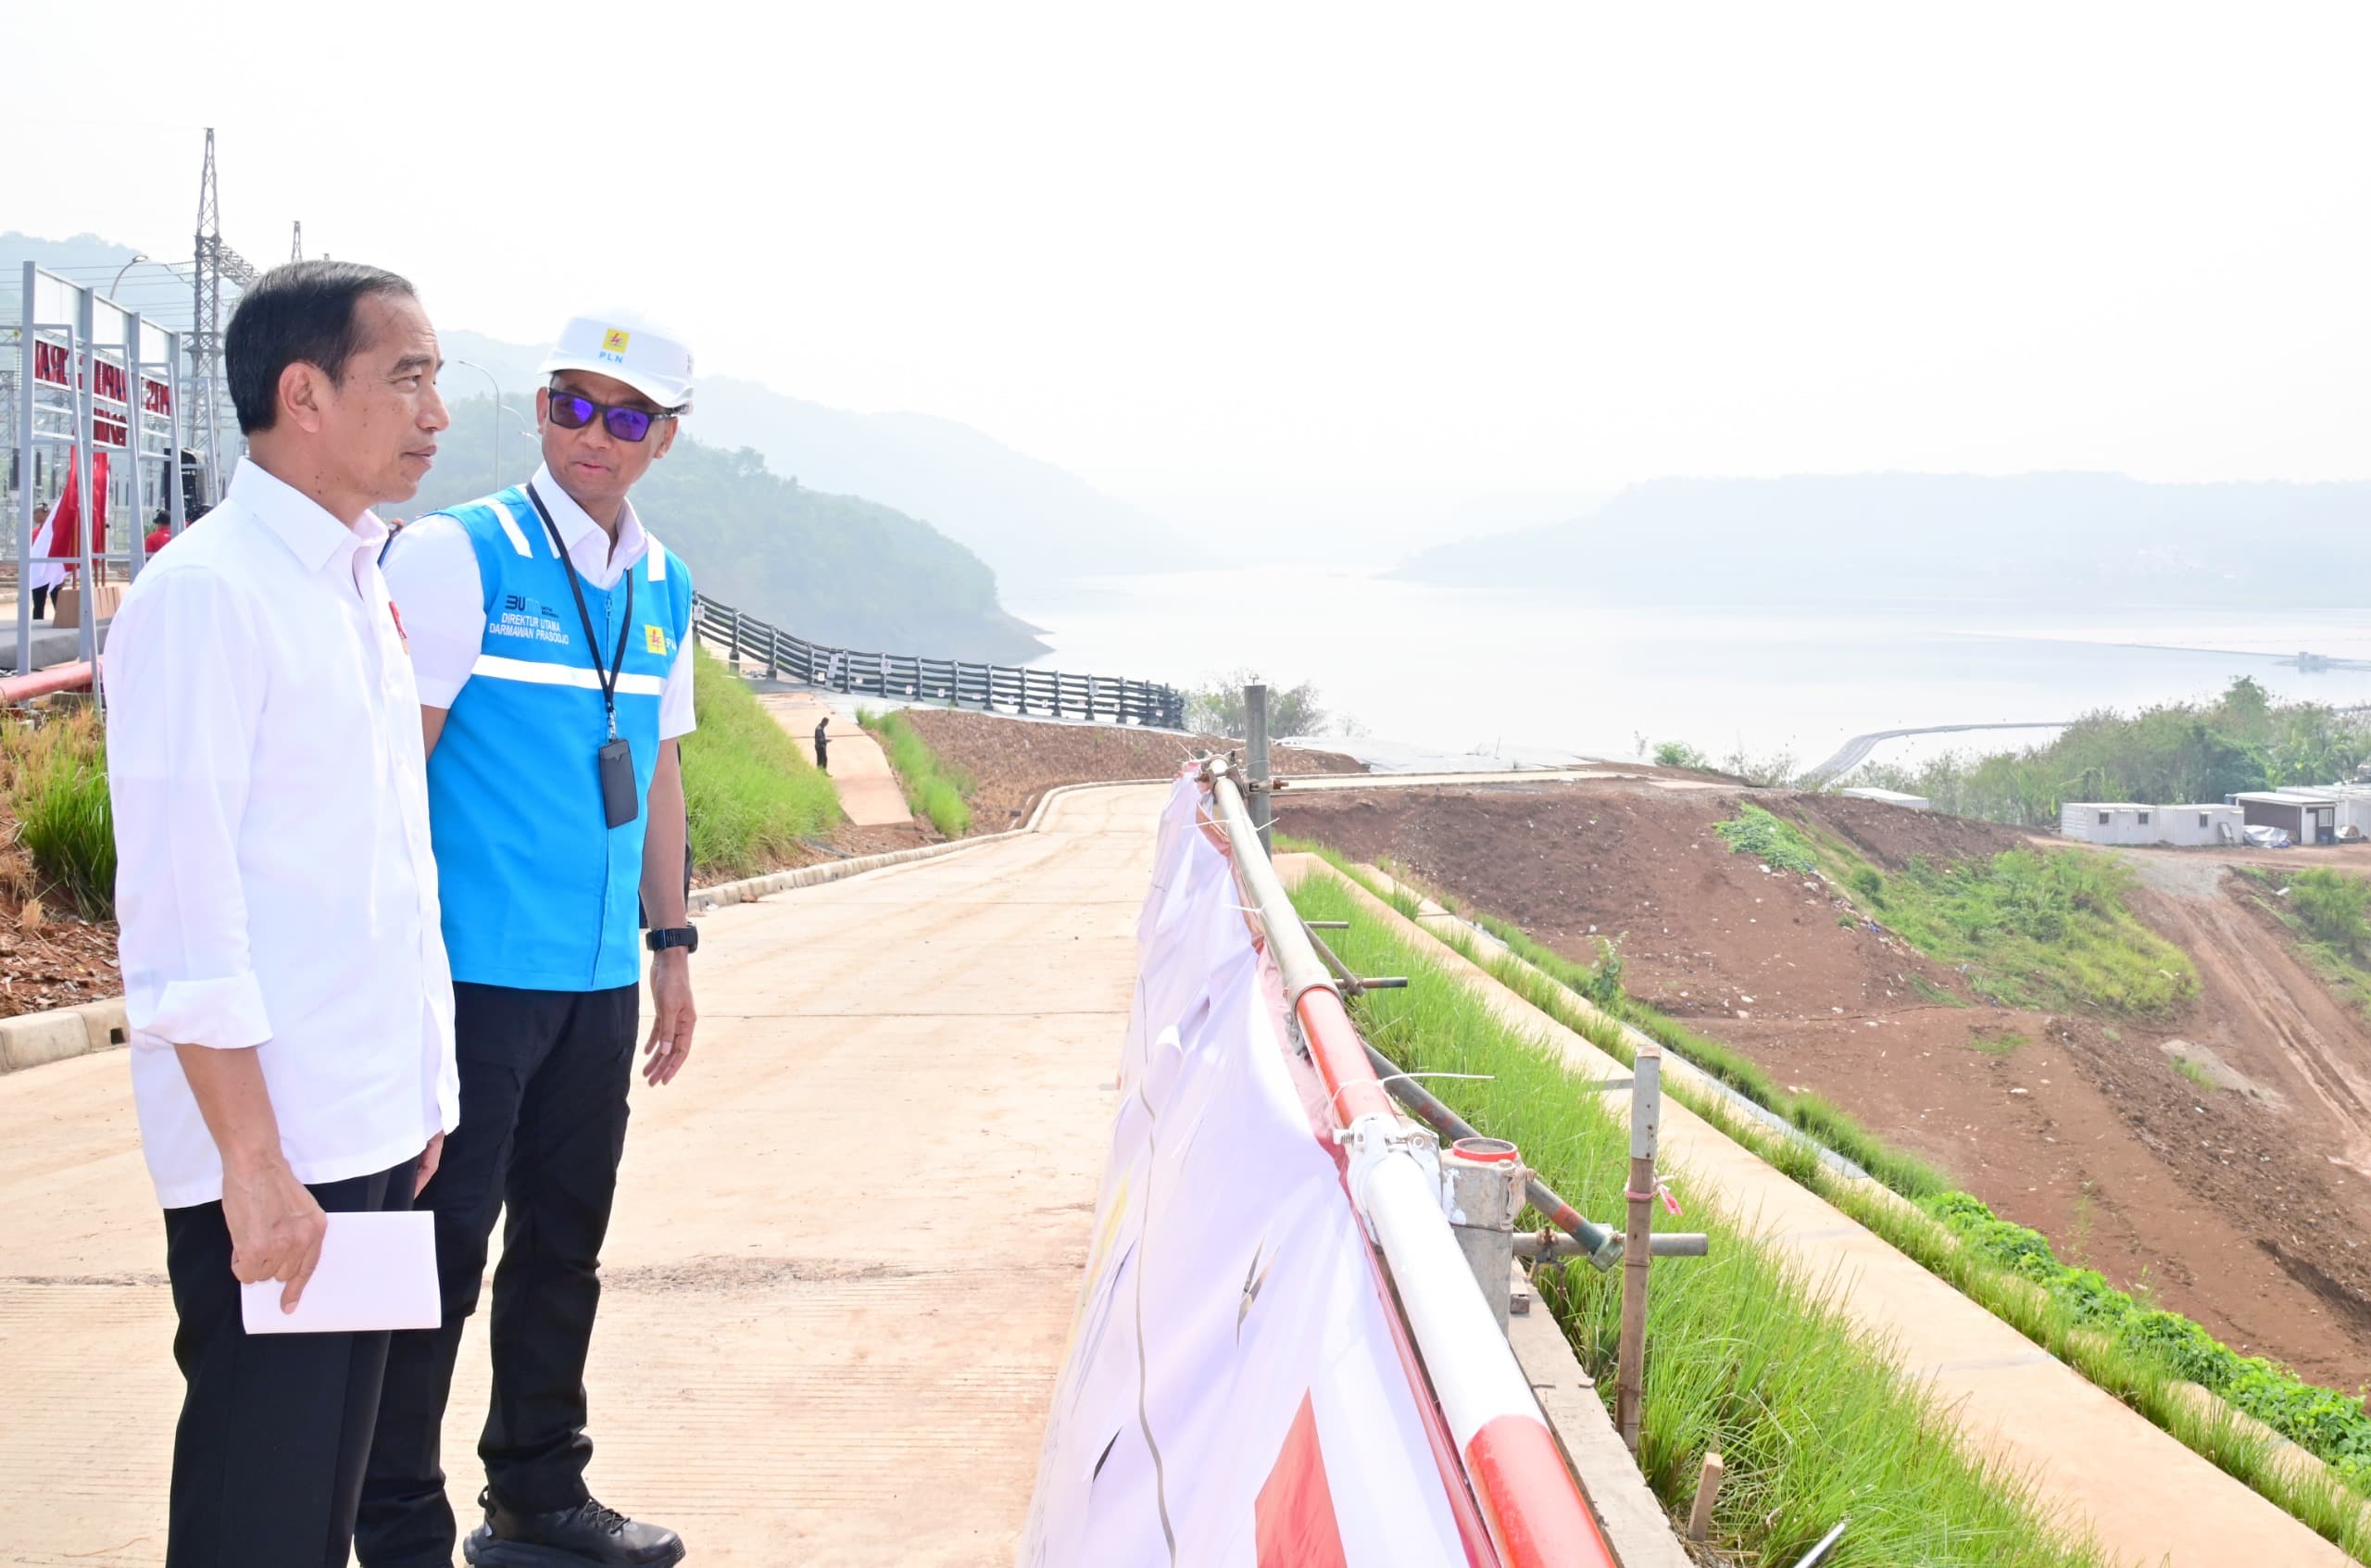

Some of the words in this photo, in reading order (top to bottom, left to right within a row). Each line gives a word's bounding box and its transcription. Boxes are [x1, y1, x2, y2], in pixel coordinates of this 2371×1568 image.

[598, 351, 623, 364] PLN
[501, 612, 539, 628] DIREKTUR
[540, 618, 560, 632] UTAMA
[489, 622, 534, 639] DARMAWAN
[535, 630, 570, 646] PRASODJO
